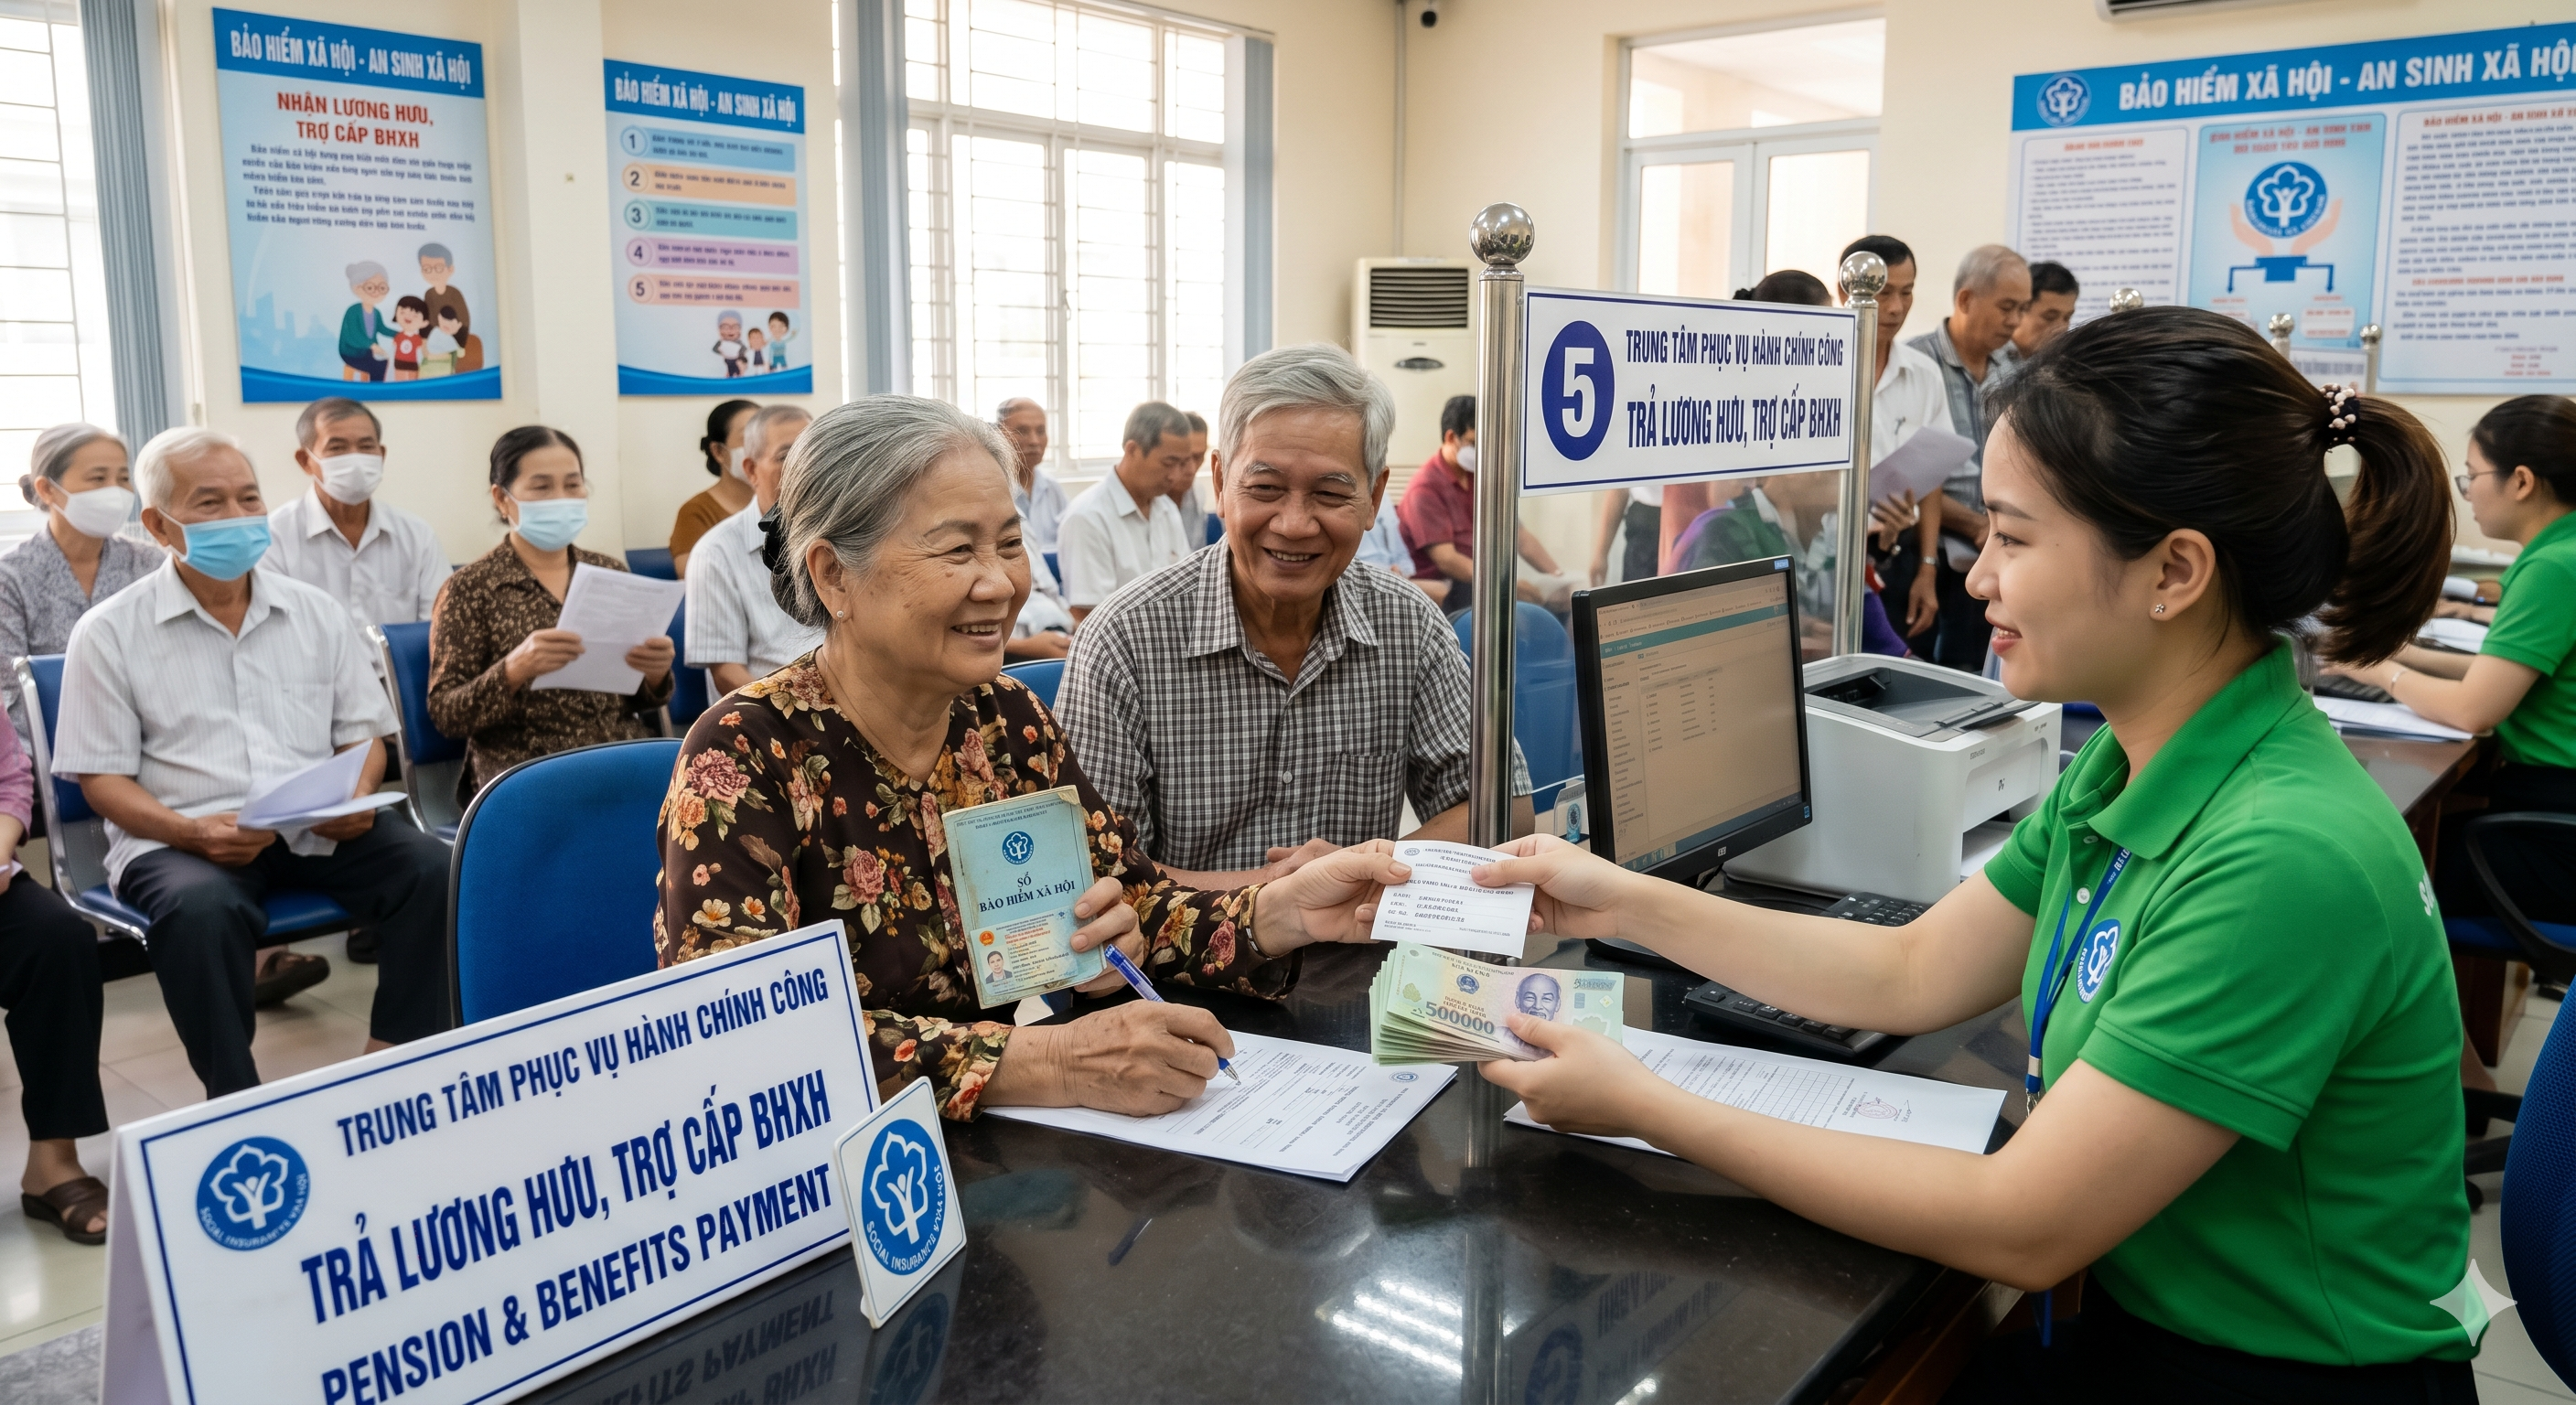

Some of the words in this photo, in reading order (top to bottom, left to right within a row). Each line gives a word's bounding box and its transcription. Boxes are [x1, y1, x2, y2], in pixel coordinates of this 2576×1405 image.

[231, 23, 262, 59] BẢO
[265, 27, 304, 64] HIỂM
[307, 36, 327, 68] XÃ
[330, 38, 356, 76] HỘI
[369, 48, 389, 75] AN
[391, 49, 424, 79] SINH
[426, 51, 446, 81] XÃ
[447, 54, 471, 90] HỘI
[2119, 71, 2169, 111] BẢO
[2174, 64, 2239, 106] HIỂM
[2244, 63, 2280, 101] XÃ
[2287, 59, 2333, 102] HỘI
[2356, 59, 2398, 92] AN
[2404, 51, 2474, 89] SINH
[2481, 42, 2522, 82] XÃ
[277, 91, 327, 117] NHẬN
[333, 97, 390, 121] LƯƠNG
[615, 70, 639, 102] BẢO
[690, 84, 709, 117] HỘI
[717, 91, 733, 115] AN
[735, 93, 760, 119] SINH
[778, 95, 796, 128] HỘI
[296, 121, 329, 145] TRỢ
[335, 119, 369, 144] CẤP
[374, 128, 420, 149] BHXH
[628, 134, 636, 149] 1
[630, 171, 640, 187] 2
[631, 208, 642, 223] 3
[634, 245, 643, 260] 4
[635, 282, 645, 297] 5
[1626, 329, 1668, 364] TRUNG
[1672, 324, 1698, 364] TÂM
[1701, 333, 1732, 371] PHỤC
[1734, 334, 1749, 372] VỤ
[1752, 328, 1782, 366] HÀNH
[1784, 330, 1816, 367] CHÍNH
[1818, 332, 1844, 367] CÔNG
[1562, 347, 1595, 438] 5
[1627, 383, 1657, 448] TRẢ
[1661, 395, 1712, 446] LƯƠNG
[1715, 394, 1748, 448] HƯU,
[1752, 394, 1778, 450] TRỢ
[1780, 382, 1806, 440] CẤP
[1809, 398, 1841, 438] BHXH
[1425, 1001, 1495, 1035] 500000
[337, 1092, 437, 1157] TRUNG
[441, 1071, 504, 1123] TÂM
[508, 1046, 580, 1102] PHỤC
[585, 1033, 619, 1079] VỤ
[624, 1010, 692, 1064] HÀNH
[696, 987, 767, 1039] CHÍNH
[769, 968, 829, 1015] CÔNG
[300, 1211, 388, 1325] TRẢ
[391, 1185, 521, 1292] LƯƠNG
[523, 1154, 610, 1239] HƯU,
[611, 1119, 677, 1201] TRỢ
[682, 1084, 743, 1175] CẤP
[748, 1068, 832, 1151] BHXH
[866, 1220, 889, 1265] SOCIAL
[321, 1306, 493, 1405] PENSION
[502, 1294, 531, 1346] &
[535, 1224, 691, 1331] BENEFITS
[695, 1163, 832, 1261] PAYMENT
